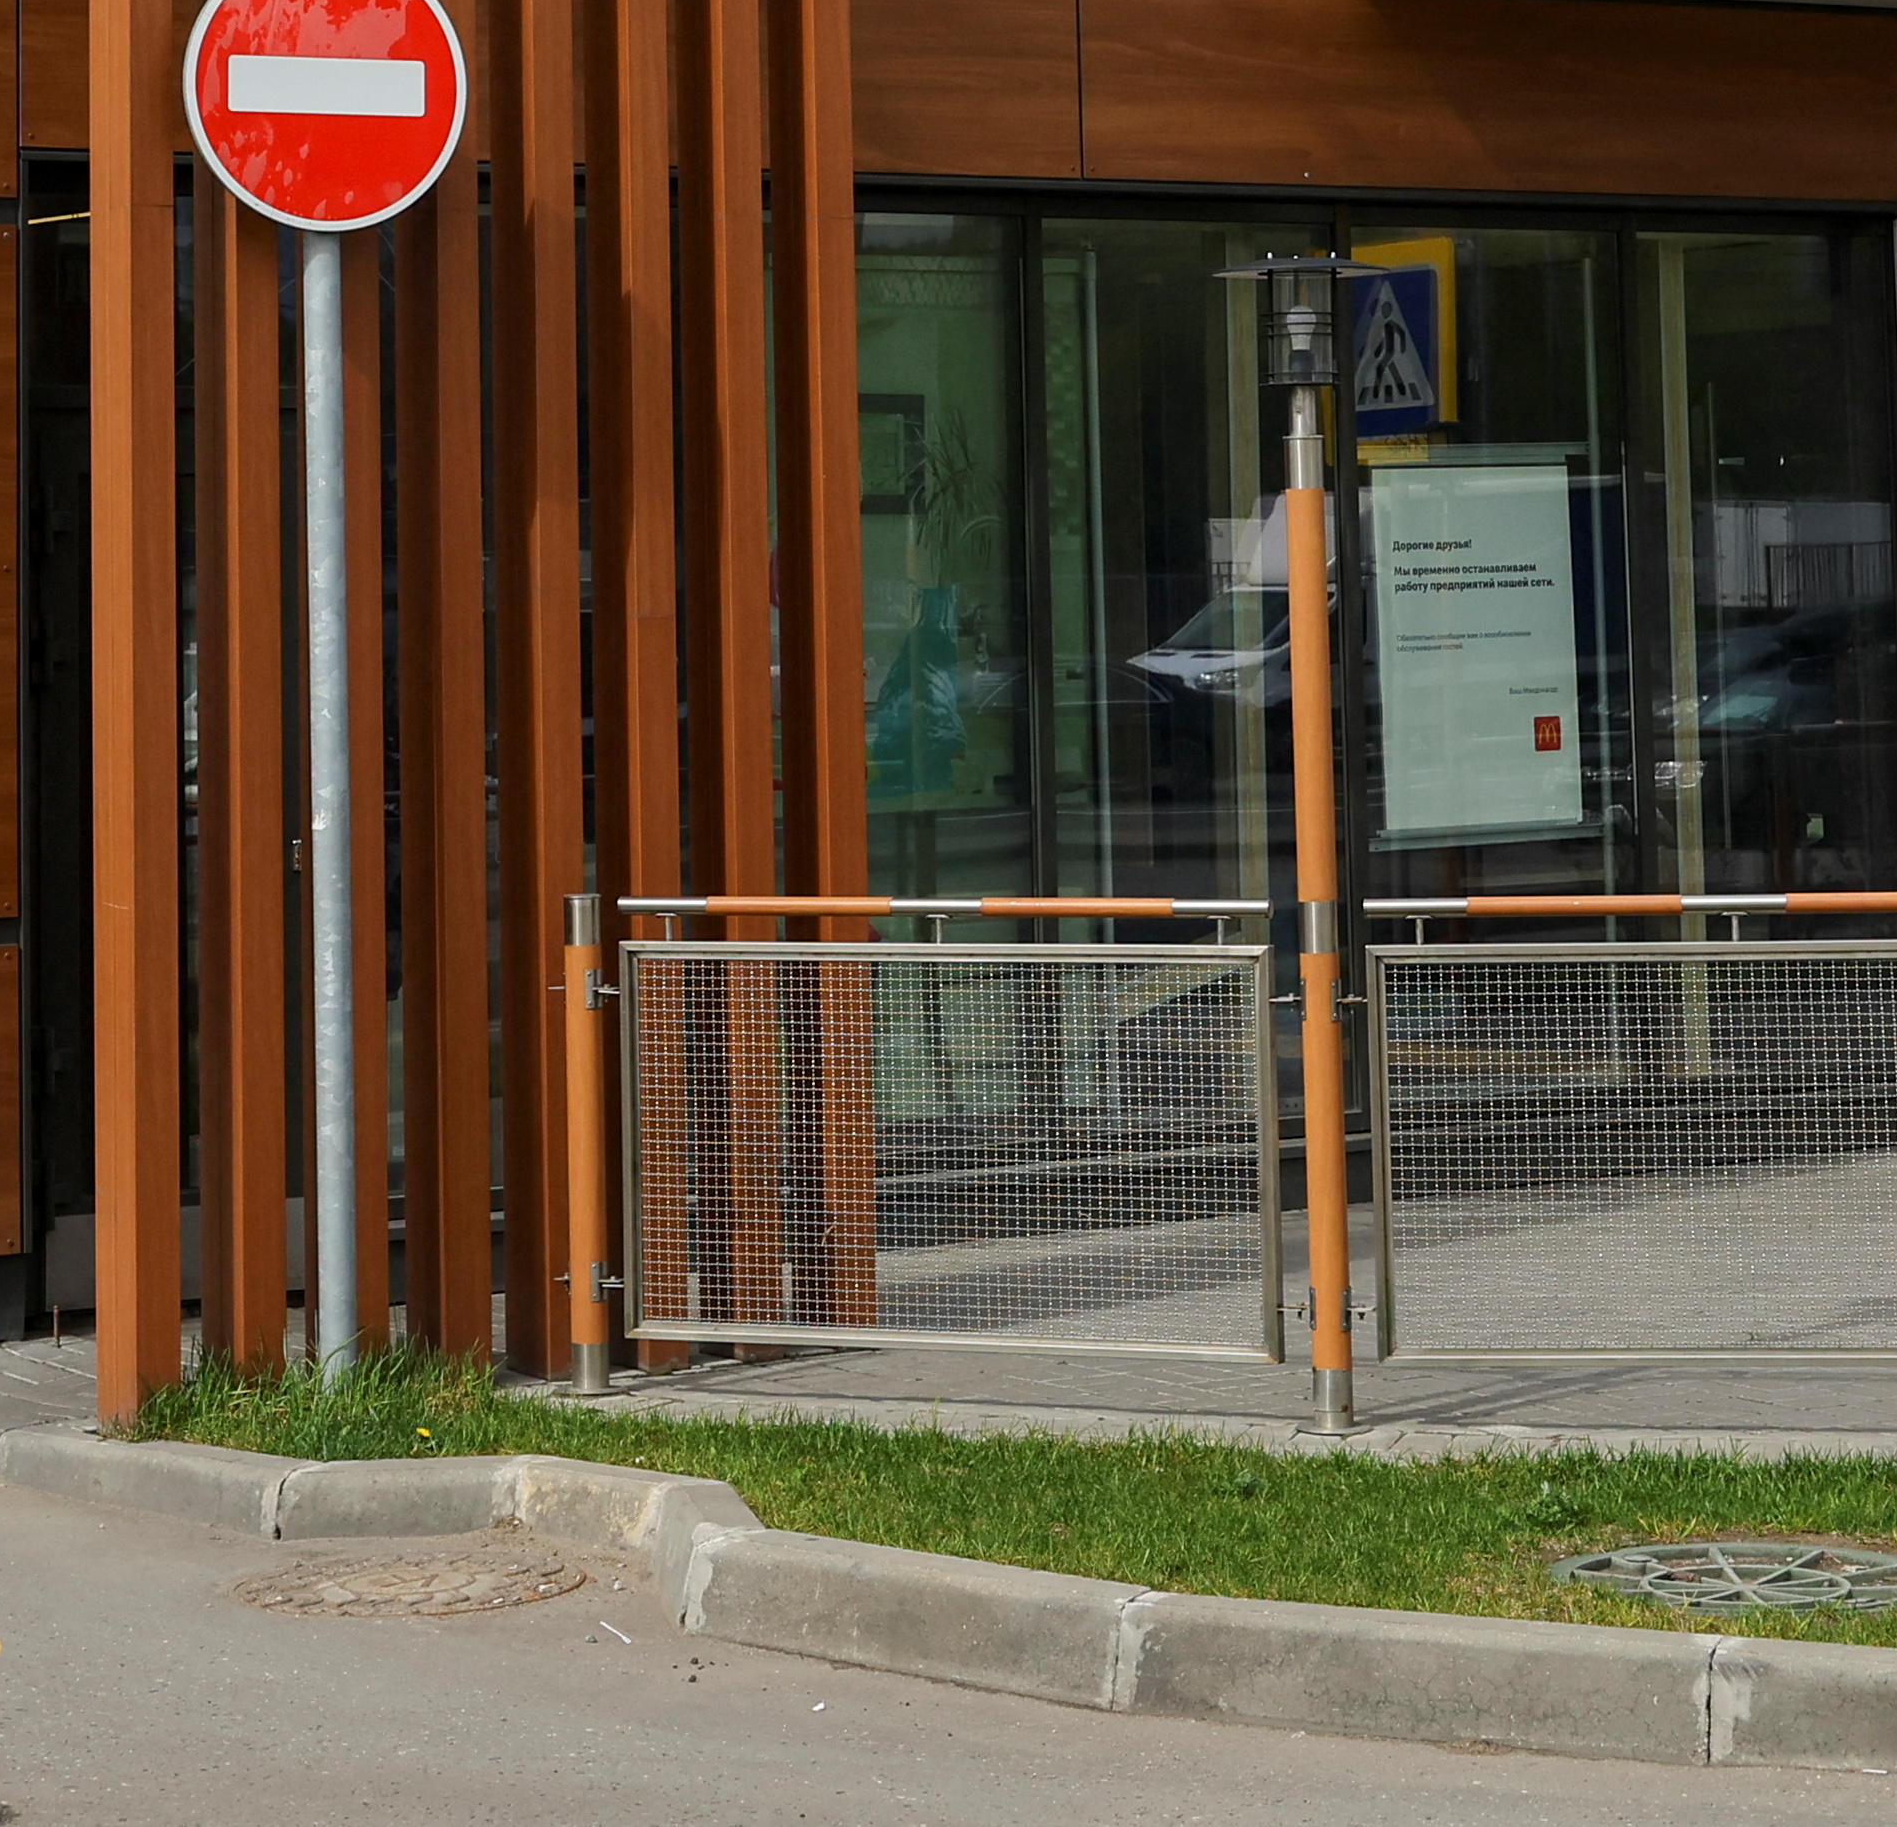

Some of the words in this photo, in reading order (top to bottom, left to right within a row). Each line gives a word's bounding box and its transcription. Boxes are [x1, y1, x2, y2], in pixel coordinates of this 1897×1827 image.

[1392, 539, 1434, 553] Дорогие
[1435, 538, 1472, 552] друзья!
[1394, 566, 1411, 576] Мы
[1412, 565, 1461, 578] временно
[1462, 562, 1537, 575] останавливаем
[1394, 580, 1429, 594] работу
[1429, 578, 1495, 593] предприятий
[1496, 576, 1529, 588] нашей
[1530, 577, 1556, 587] сети.
